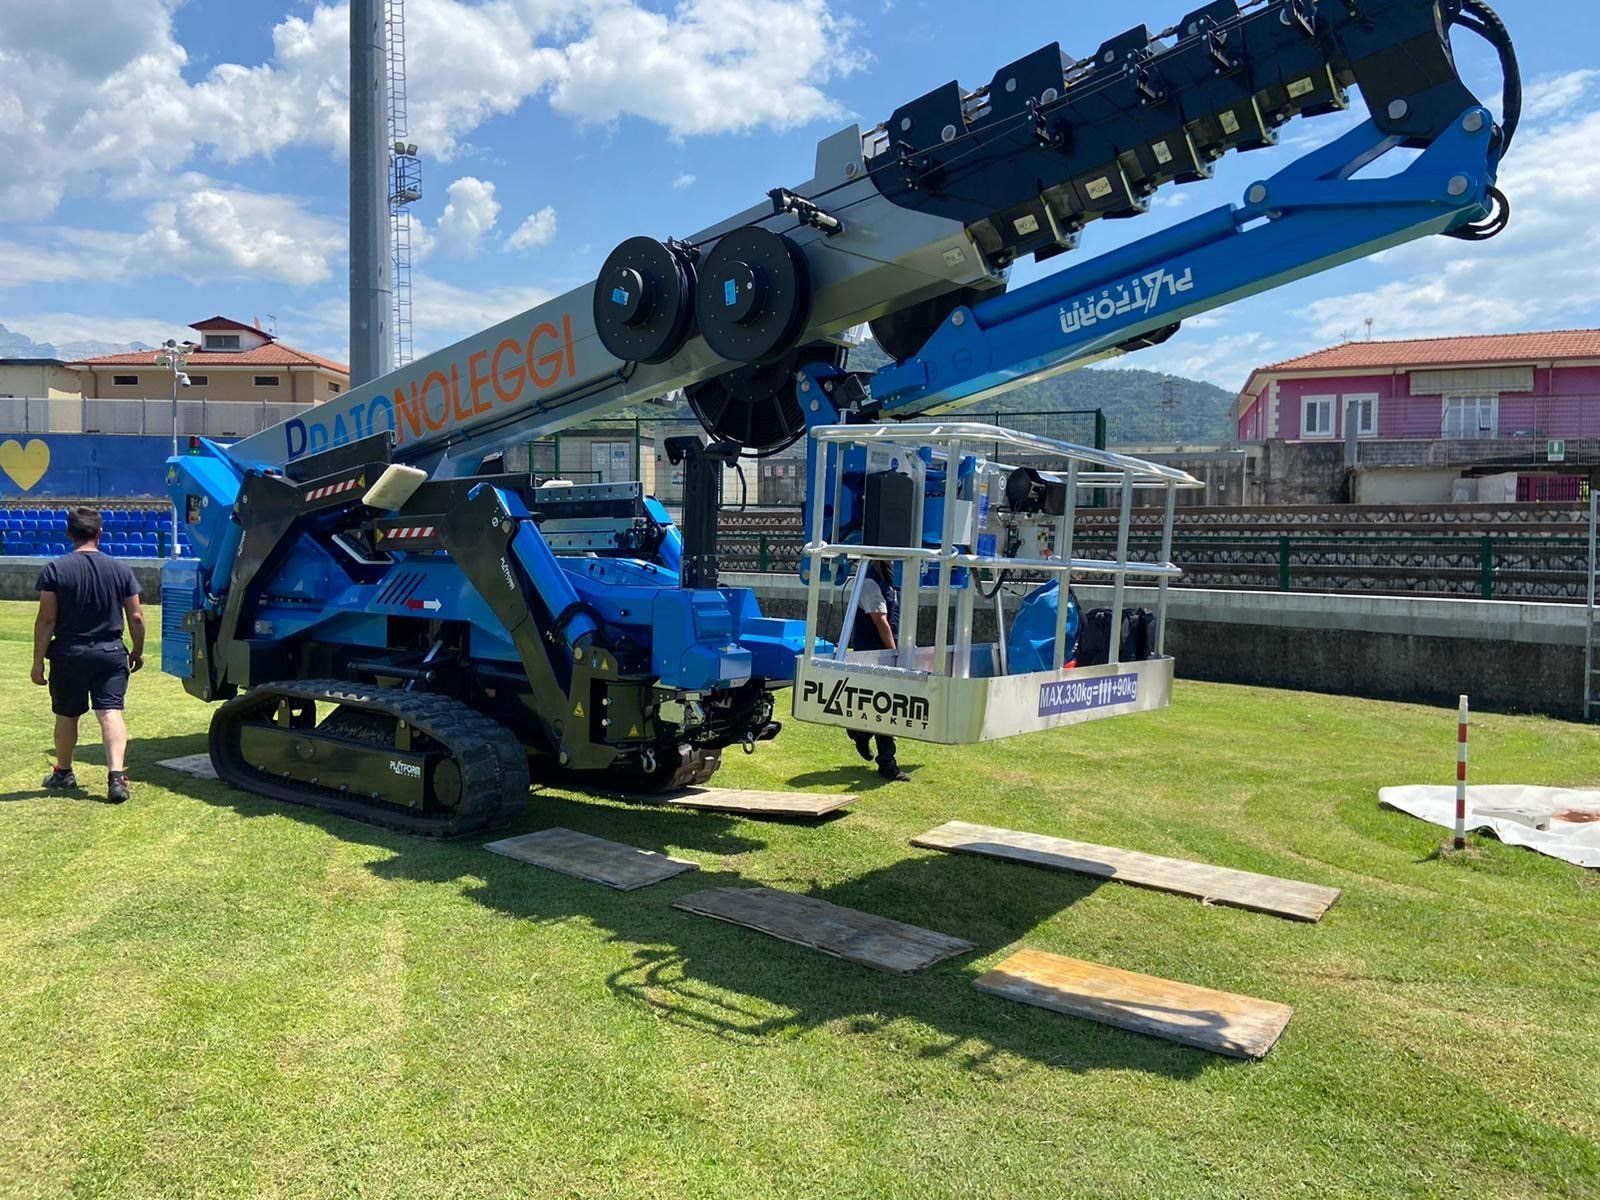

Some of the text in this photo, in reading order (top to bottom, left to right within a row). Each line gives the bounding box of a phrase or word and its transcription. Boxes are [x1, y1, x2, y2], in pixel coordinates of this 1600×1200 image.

[1060, 267, 1194, 334] PLATFORM
[803, 677, 930, 722] PLATFORM
[846, 709, 929, 731] BASKET
